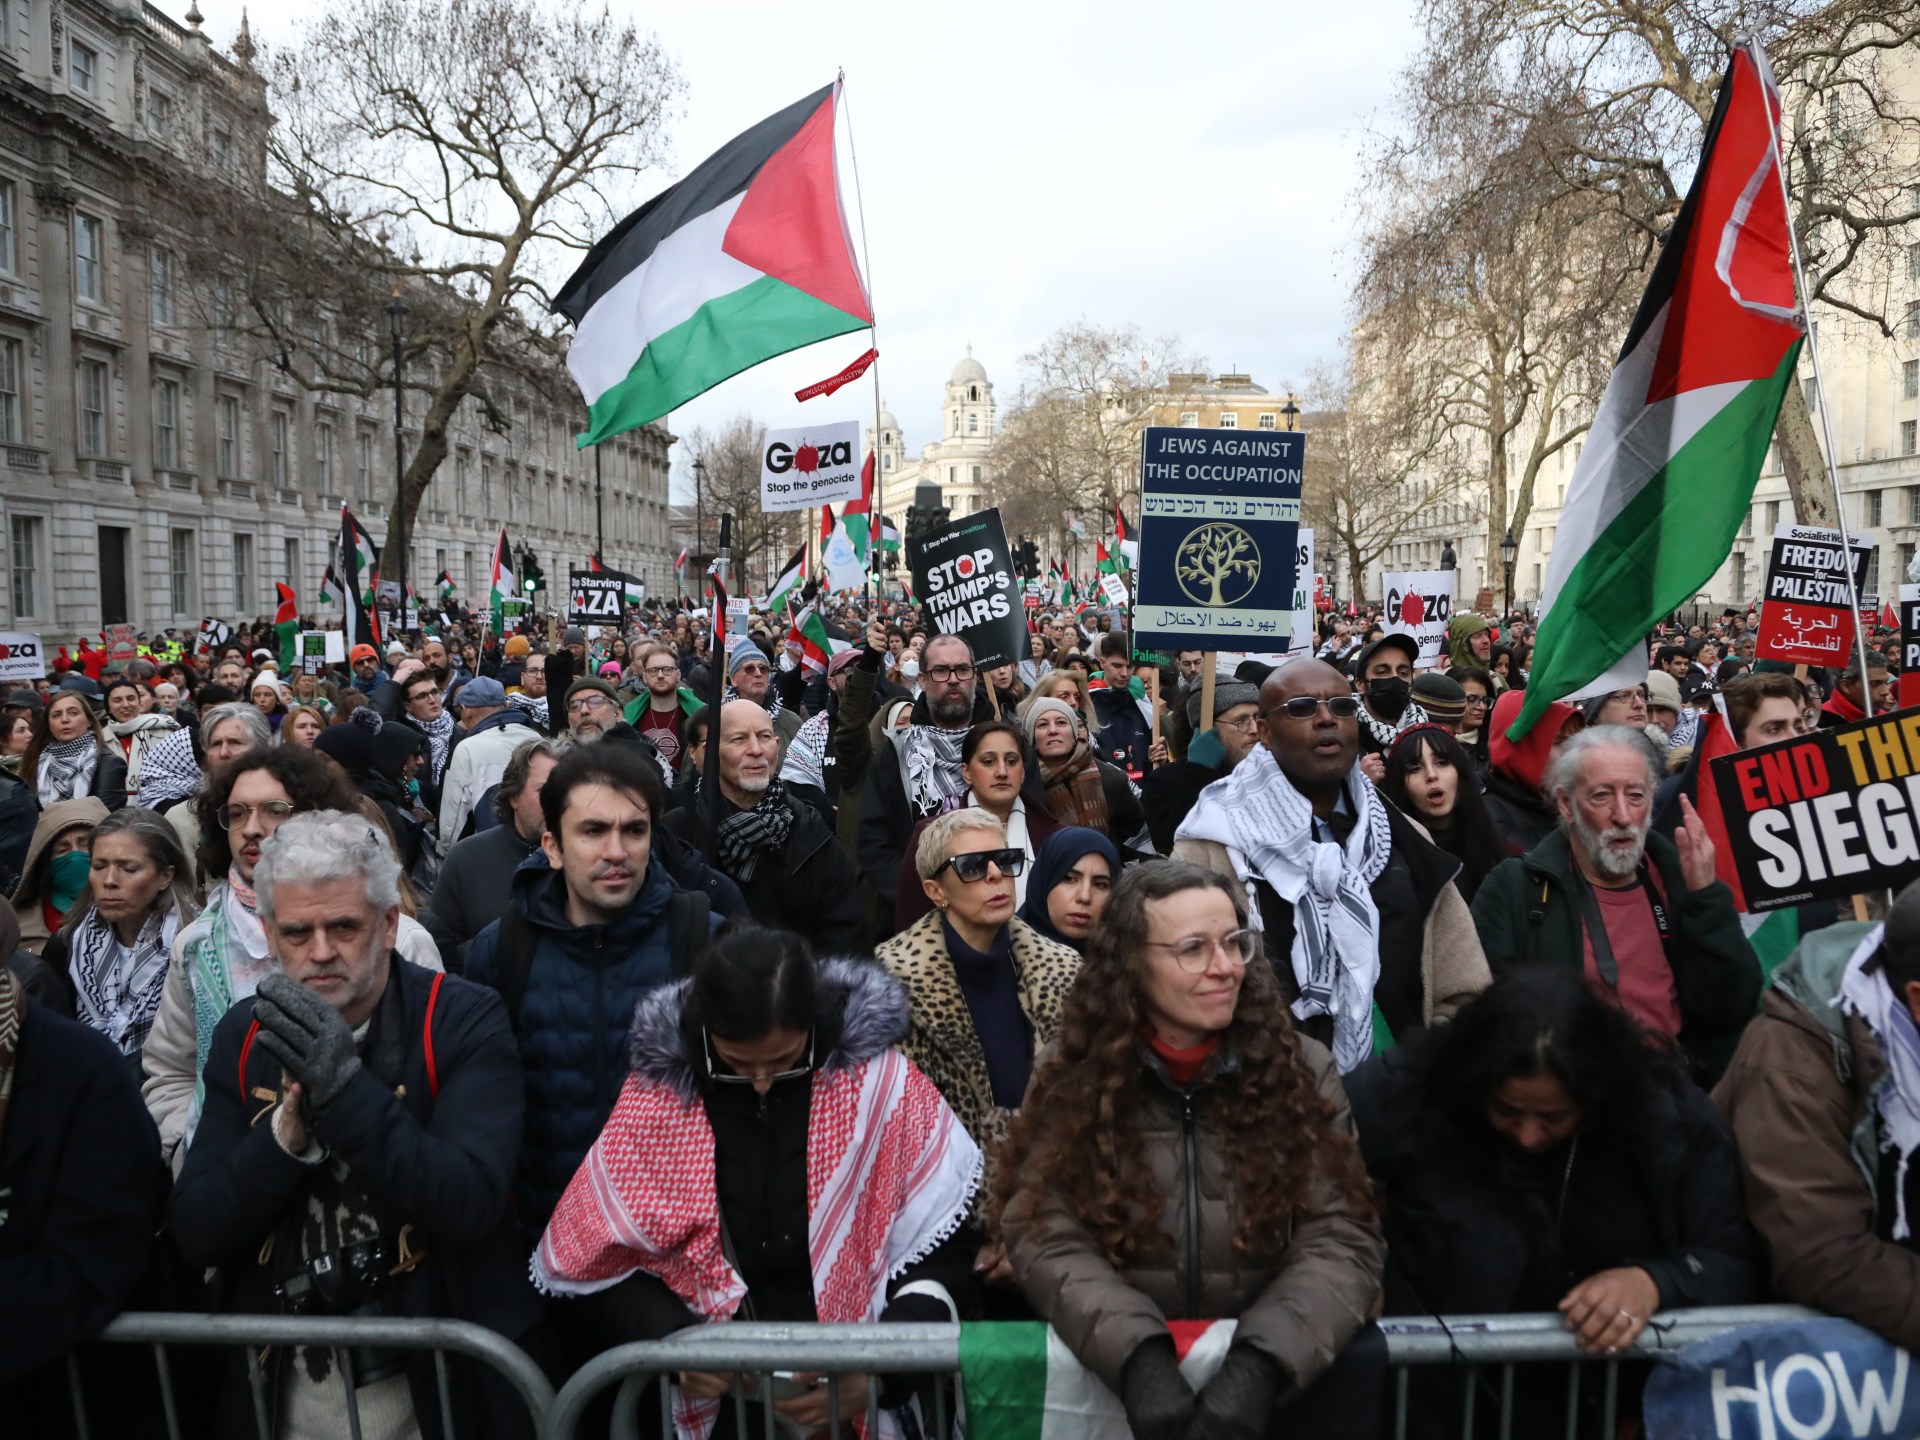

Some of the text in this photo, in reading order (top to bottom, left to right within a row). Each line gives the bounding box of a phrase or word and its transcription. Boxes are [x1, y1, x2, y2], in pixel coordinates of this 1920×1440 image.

[1159, 437, 1292, 458] JEWS AGAINST
[767, 473, 855, 494] Stop the genocide
[1146, 463, 1301, 484] THE OCCUPATION
[1145, 498, 1299, 516] יהודים נגד הכיבוש
[928, 523, 987, 549] Stop the War coalition
[1791, 529, 1831, 542] Socialist
[927, 548, 994, 592] STOP
[1781, 544, 1860, 573] FREEDOM
[581, 577, 621, 590] Starving
[1814, 569, 1828, 580] for
[571, 589, 620, 615] GAZA
[926, 570, 1010, 614] TRUMP'S
[1771, 576, 1858, 605] PALESTIN
[934, 593, 1010, 634] WARS
[1156, 610, 1277, 632] يهود ضد الاحتلال
[1782, 608, 1838, 631] الحرية
[1770, 631, 1842, 651] لفلسطين
[5, 662, 40, 670] genocide
[1132, 648, 1170, 666] Palestine
[1734, 715, 1920, 812] END THE
[1749, 774, 1920, 888] SIEG
[1654, 905, 1668, 930] RX10
[1711, 1347, 1909, 1440] HOW
